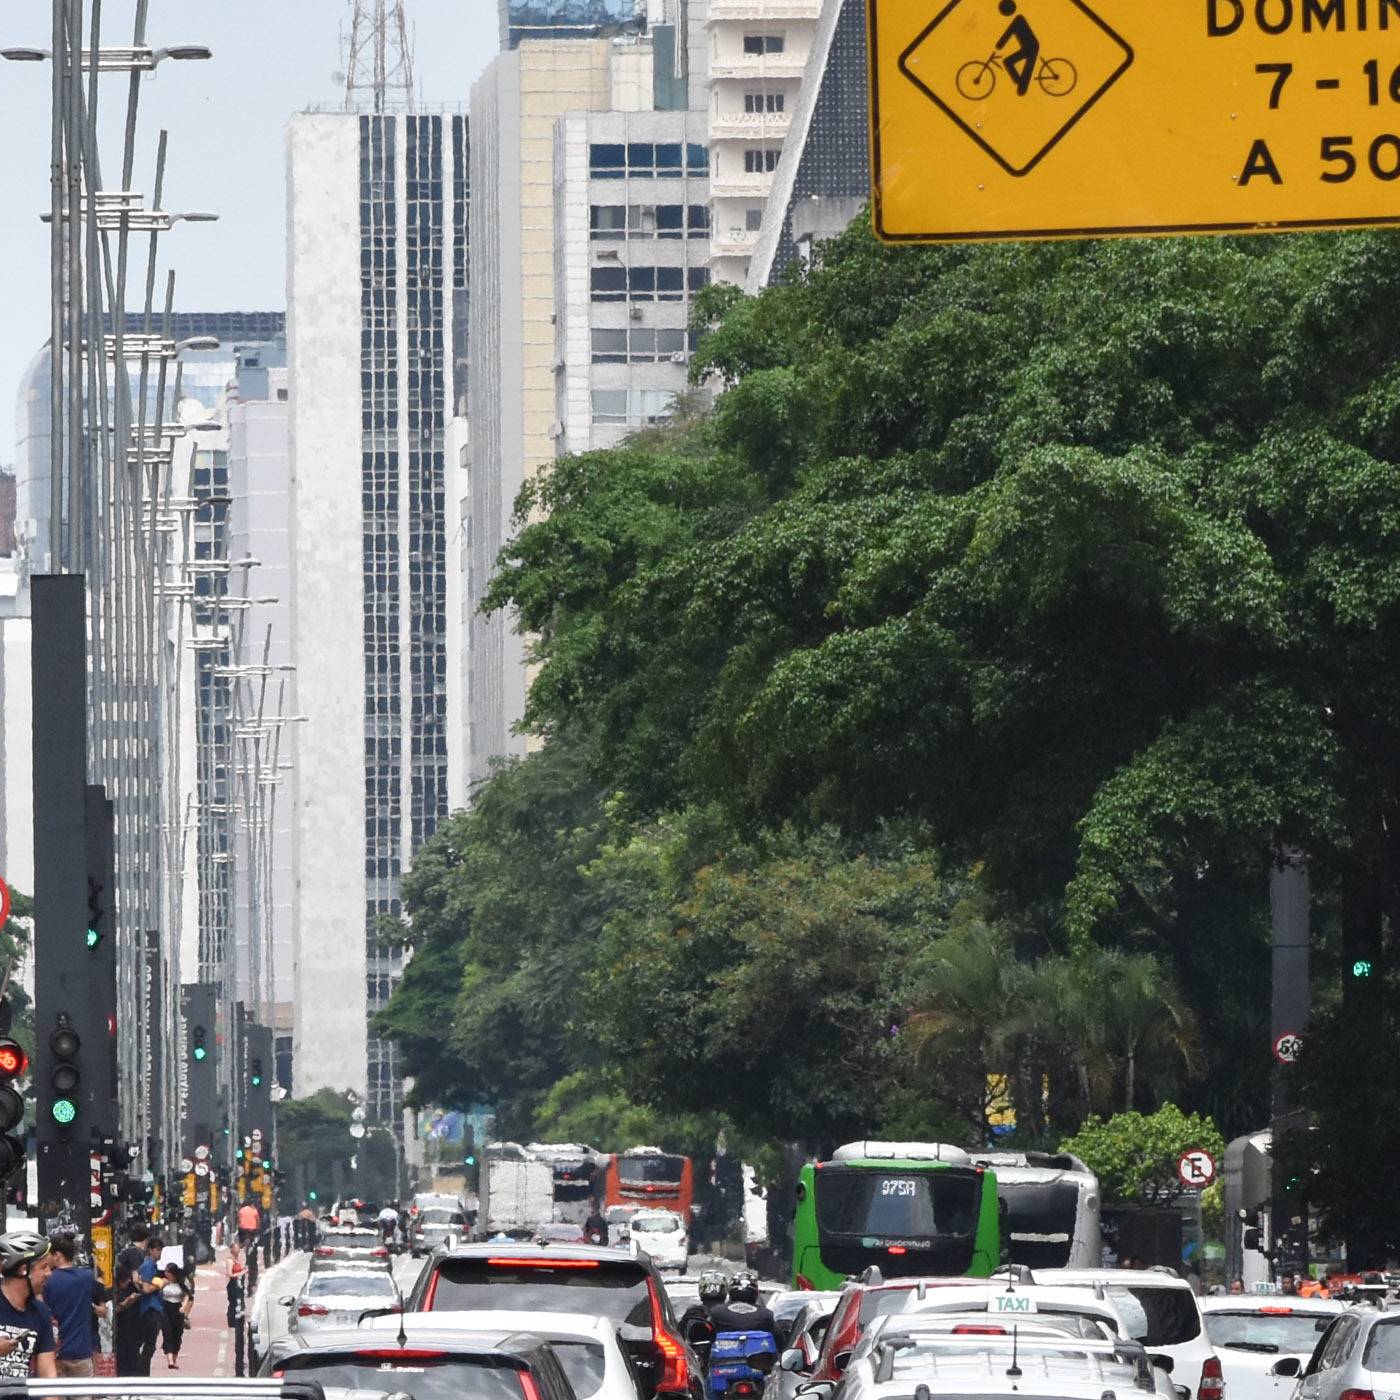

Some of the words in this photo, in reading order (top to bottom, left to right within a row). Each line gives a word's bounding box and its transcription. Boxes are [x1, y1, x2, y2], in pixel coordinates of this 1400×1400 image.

[1255, 62, 1293, 110] 7
[1237, 138, 1284, 187] A
[995, 1297, 1030, 1311] TAXI
